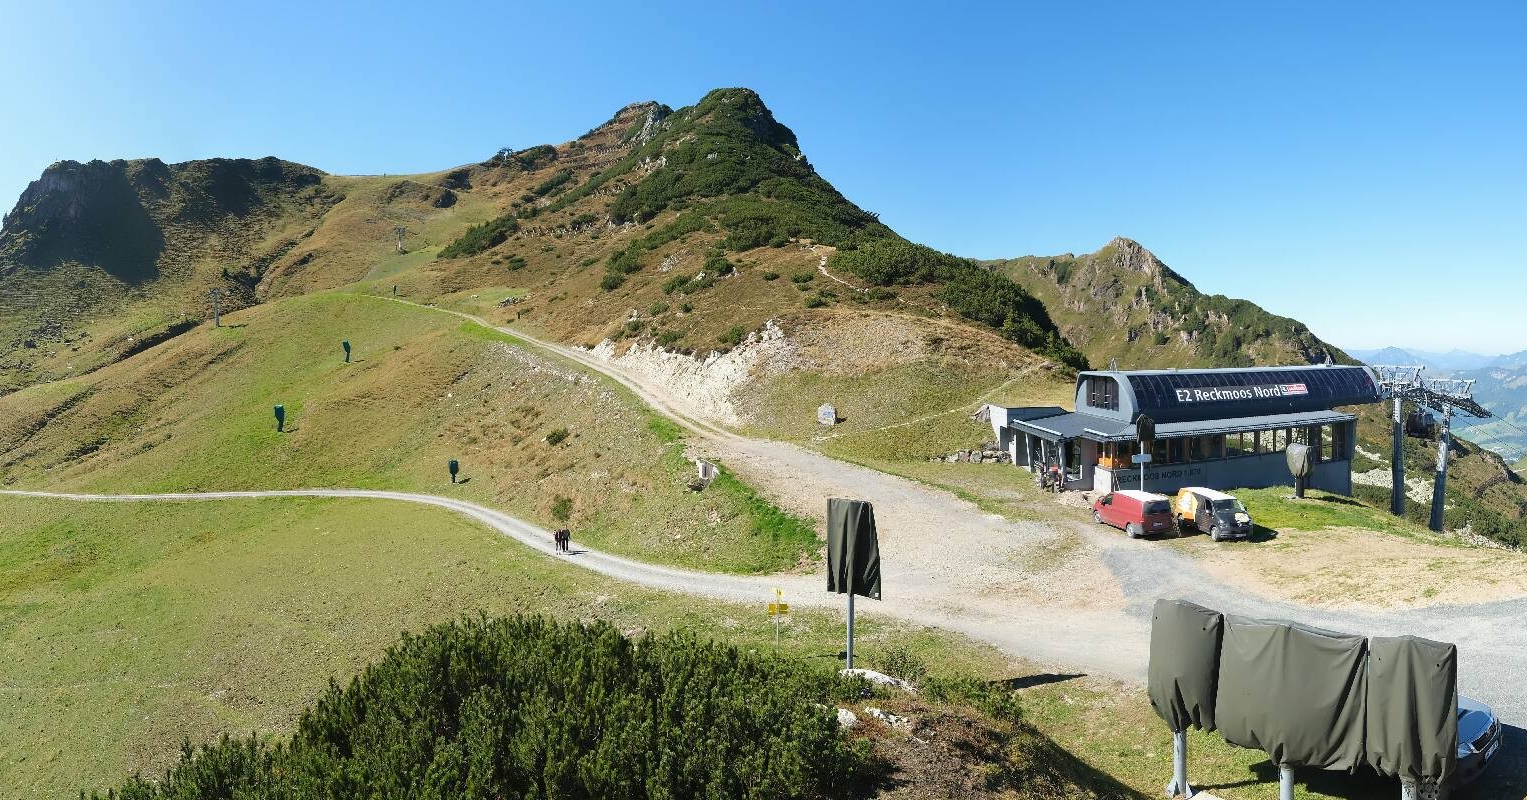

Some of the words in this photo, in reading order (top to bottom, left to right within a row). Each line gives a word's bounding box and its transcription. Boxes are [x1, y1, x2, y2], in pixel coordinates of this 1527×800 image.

[1176, 389, 1193, 402] E2
[1194, 387, 1252, 401] Reckmoos
[1253, 385, 1281, 398] Nord
[1161, 470, 1182, 480] NORD
